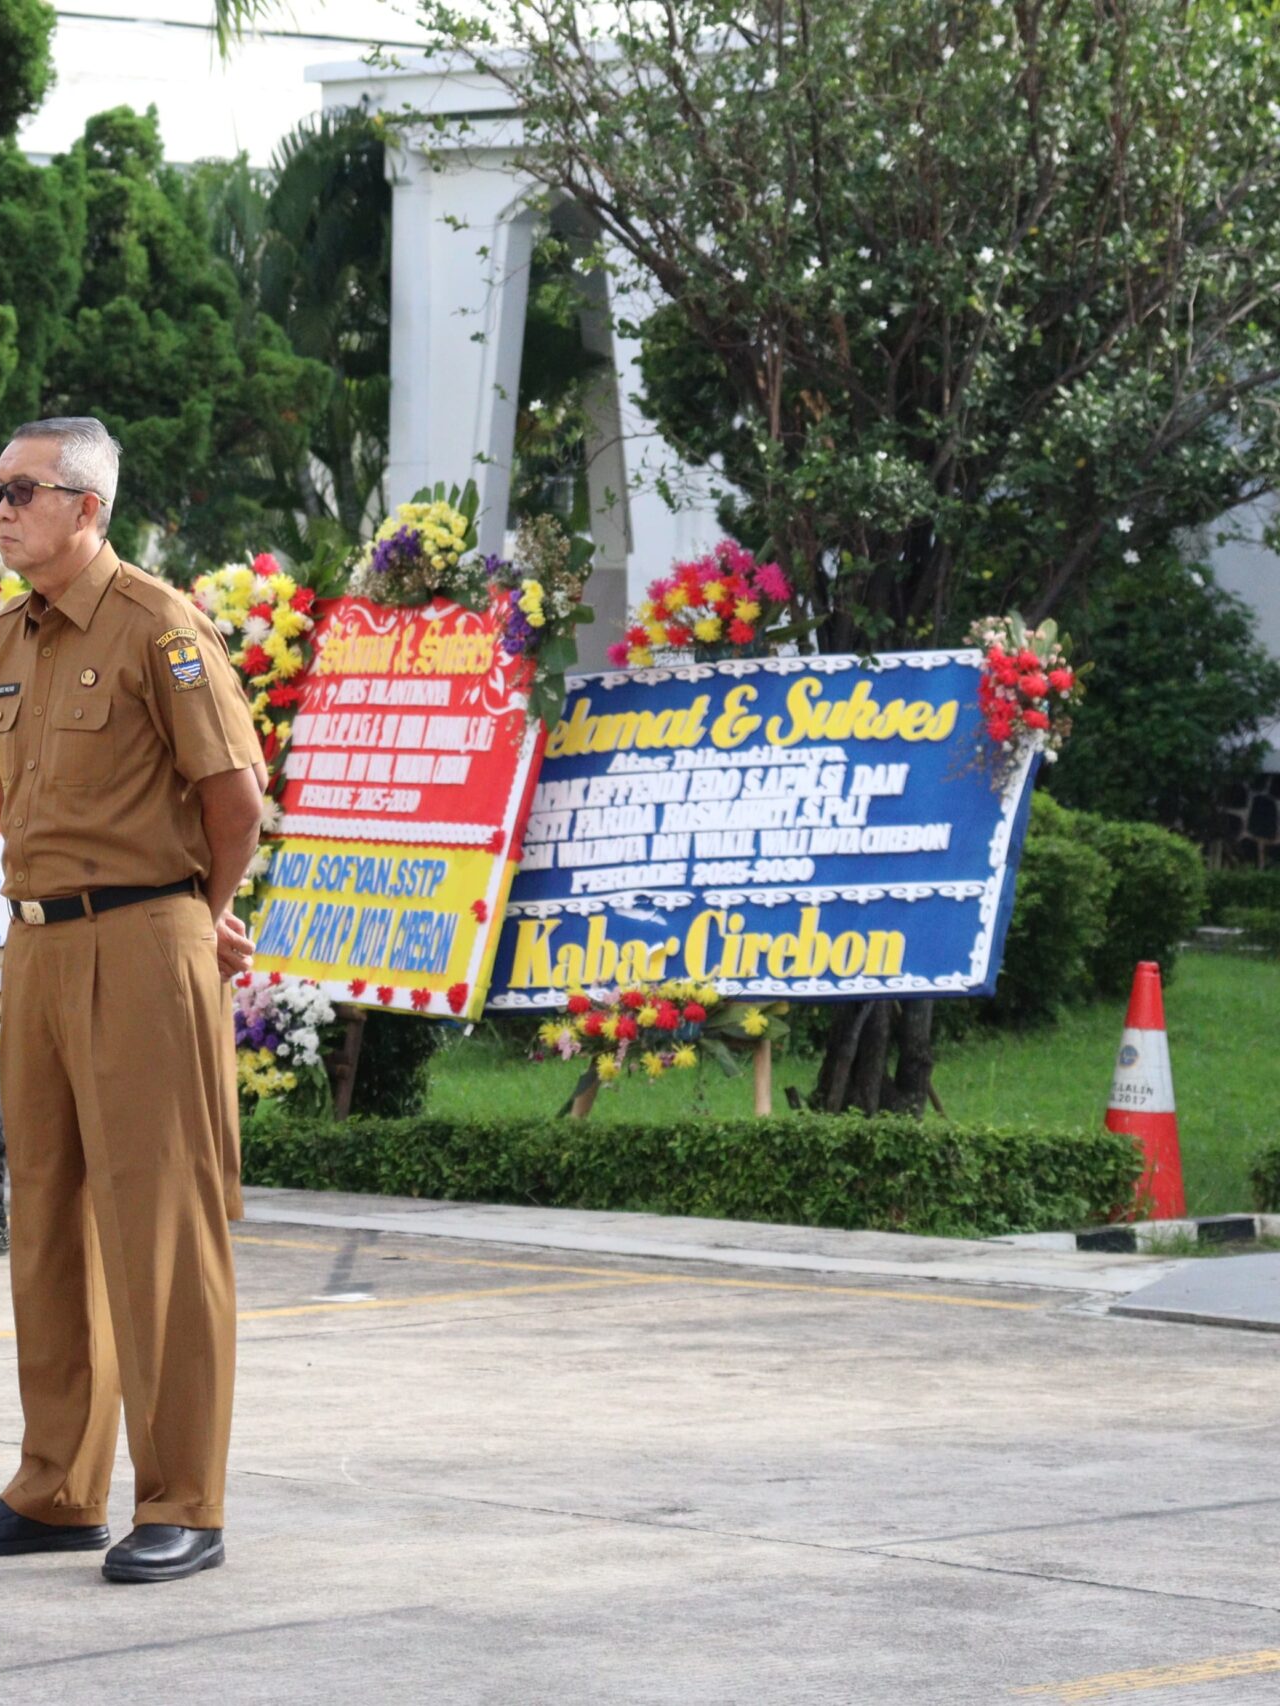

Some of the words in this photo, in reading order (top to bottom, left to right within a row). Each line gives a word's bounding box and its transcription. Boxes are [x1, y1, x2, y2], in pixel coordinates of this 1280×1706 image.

[545, 695, 710, 759] elamat
[710, 684, 761, 748] &
[765, 677, 959, 747] Sukses
[849, 763, 910, 796] DAN
[691, 857, 816, 886] 2025-2030
[507, 915, 680, 989] Kabar
[683, 906, 906, 983] Cirebon
